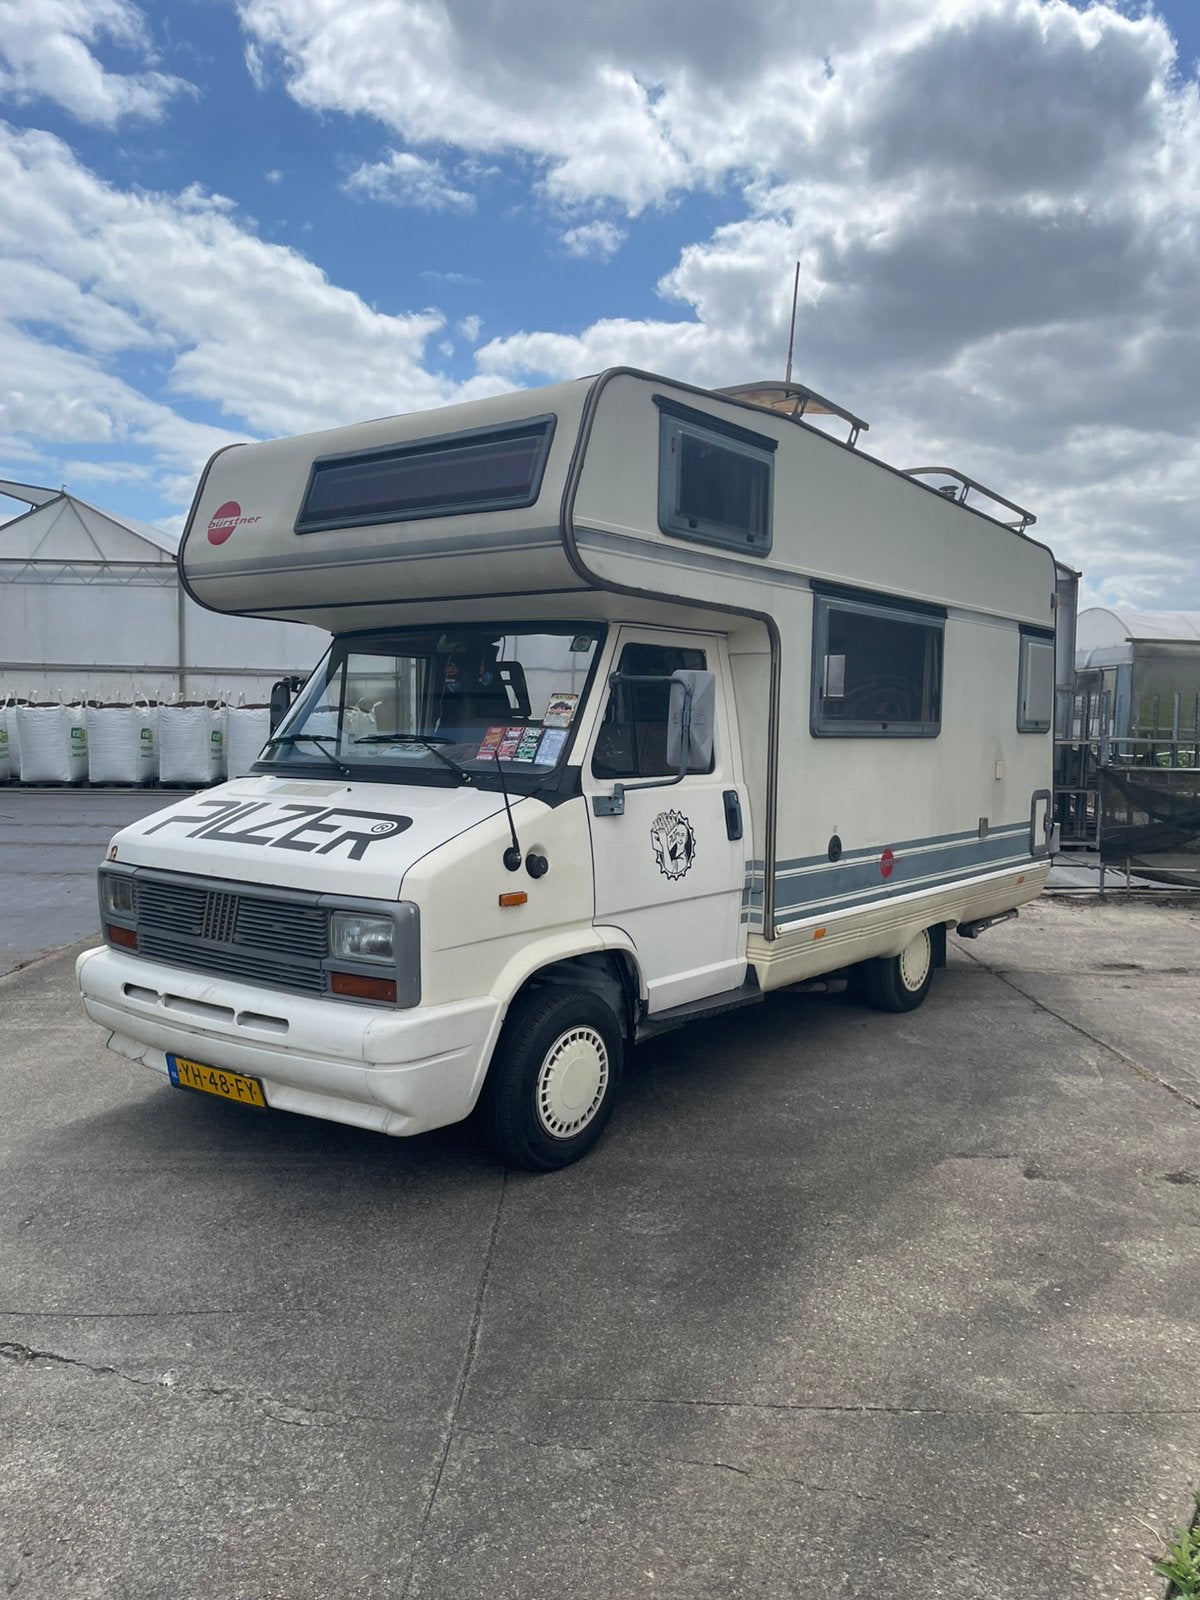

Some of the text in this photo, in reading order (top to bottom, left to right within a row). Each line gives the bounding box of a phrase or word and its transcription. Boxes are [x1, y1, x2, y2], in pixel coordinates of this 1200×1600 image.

[208, 516, 262, 528] bürstner
[142, 800, 413, 861] PILZER
[180, 1062, 255, 1101] YH-48-FY
